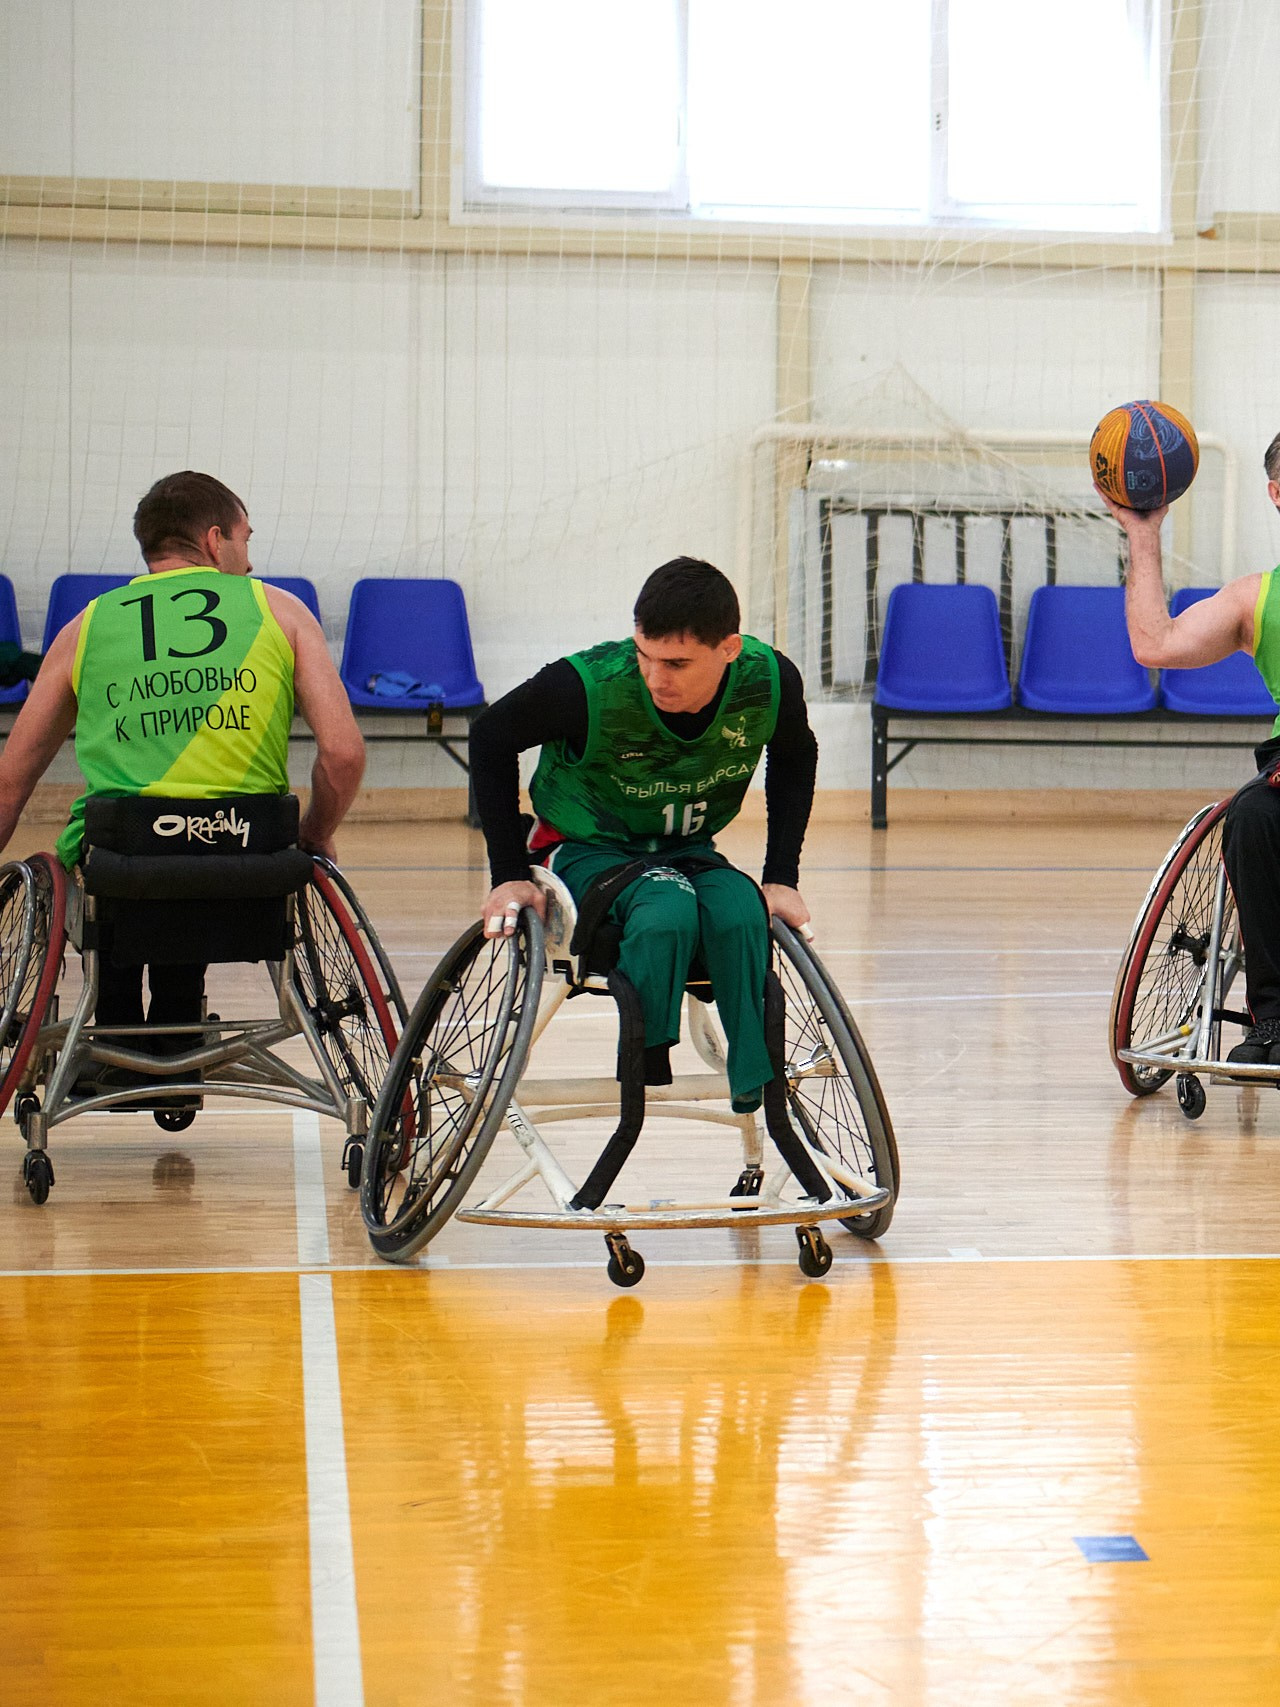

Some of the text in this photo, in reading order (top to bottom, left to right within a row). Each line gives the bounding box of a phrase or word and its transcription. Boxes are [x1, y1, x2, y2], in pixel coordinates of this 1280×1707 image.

[119, 588, 228, 662] 13
[106, 667, 257, 708] С ЛЮБОВЬЮ
[115, 704, 251, 742] К ПРИРОДЕ
[662, 801, 708, 837] 16
